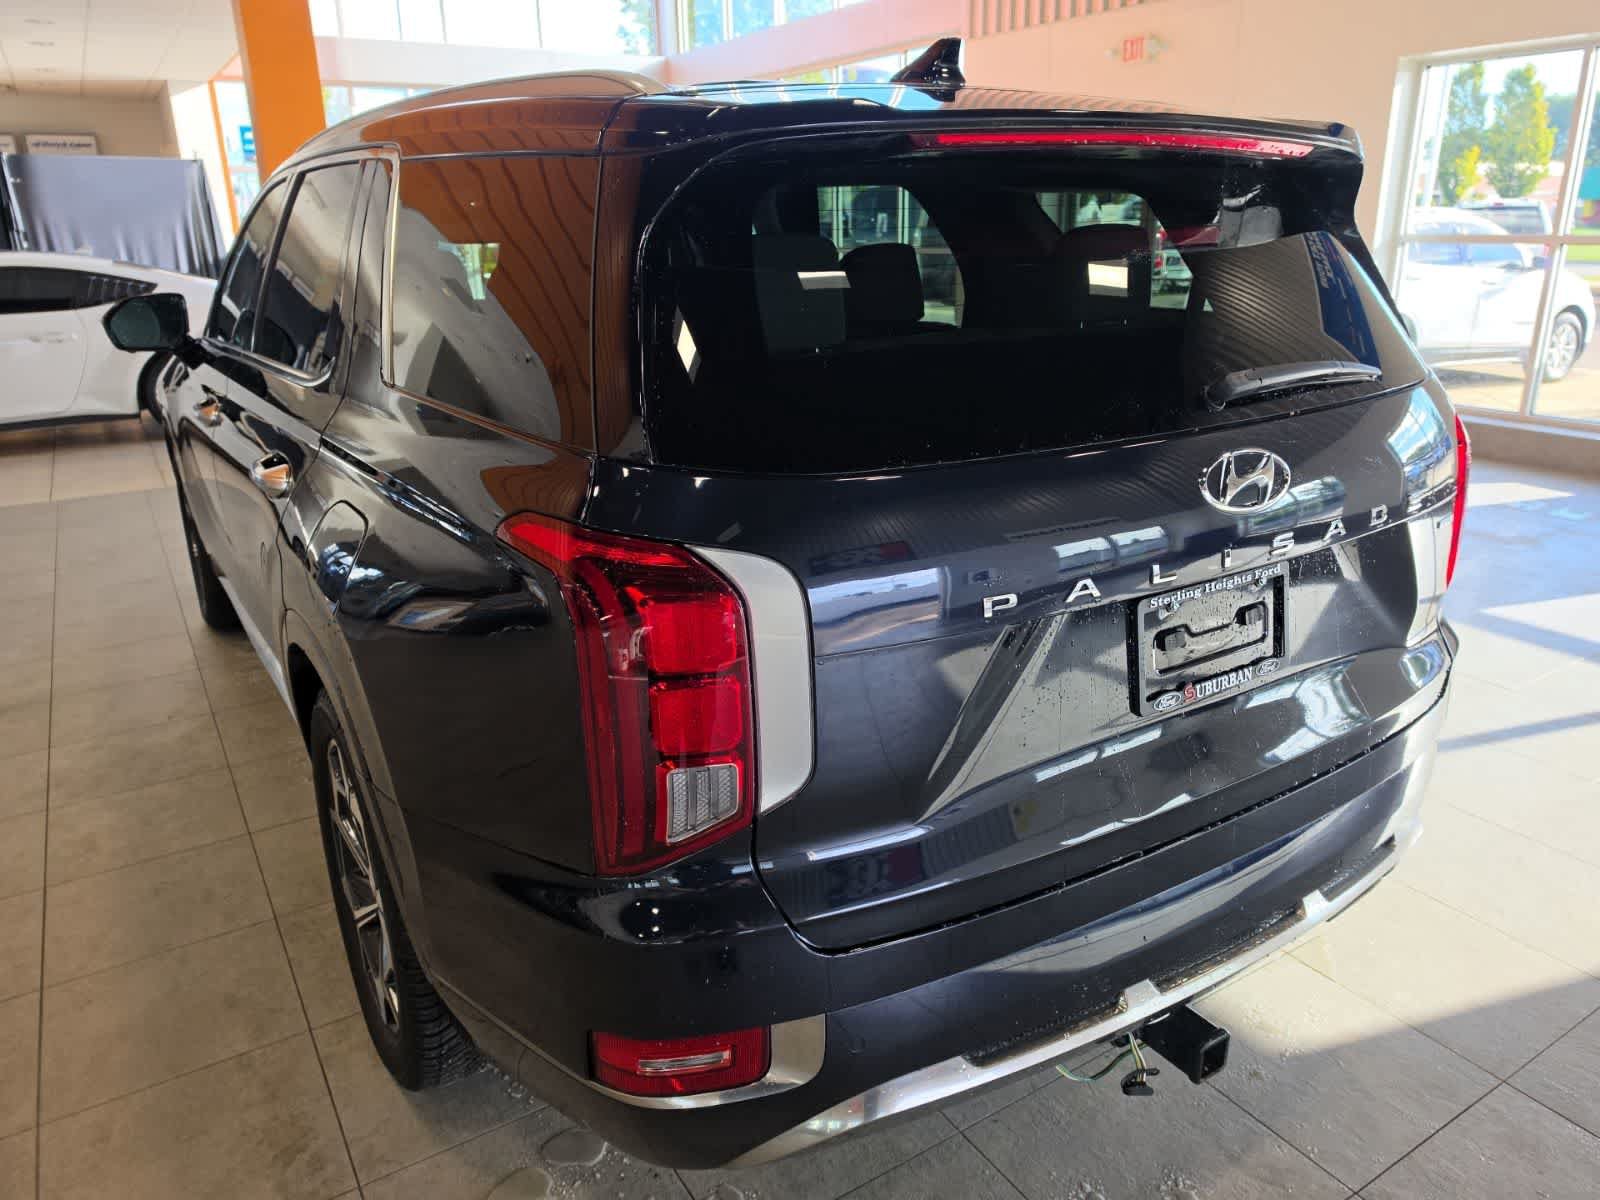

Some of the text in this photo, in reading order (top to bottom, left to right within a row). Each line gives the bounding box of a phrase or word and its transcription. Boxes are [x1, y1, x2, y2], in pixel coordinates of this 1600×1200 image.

[1150, 564, 1281, 609] Sterling Heights Ford
[1184, 666, 1253, 702] SUBURBAN
